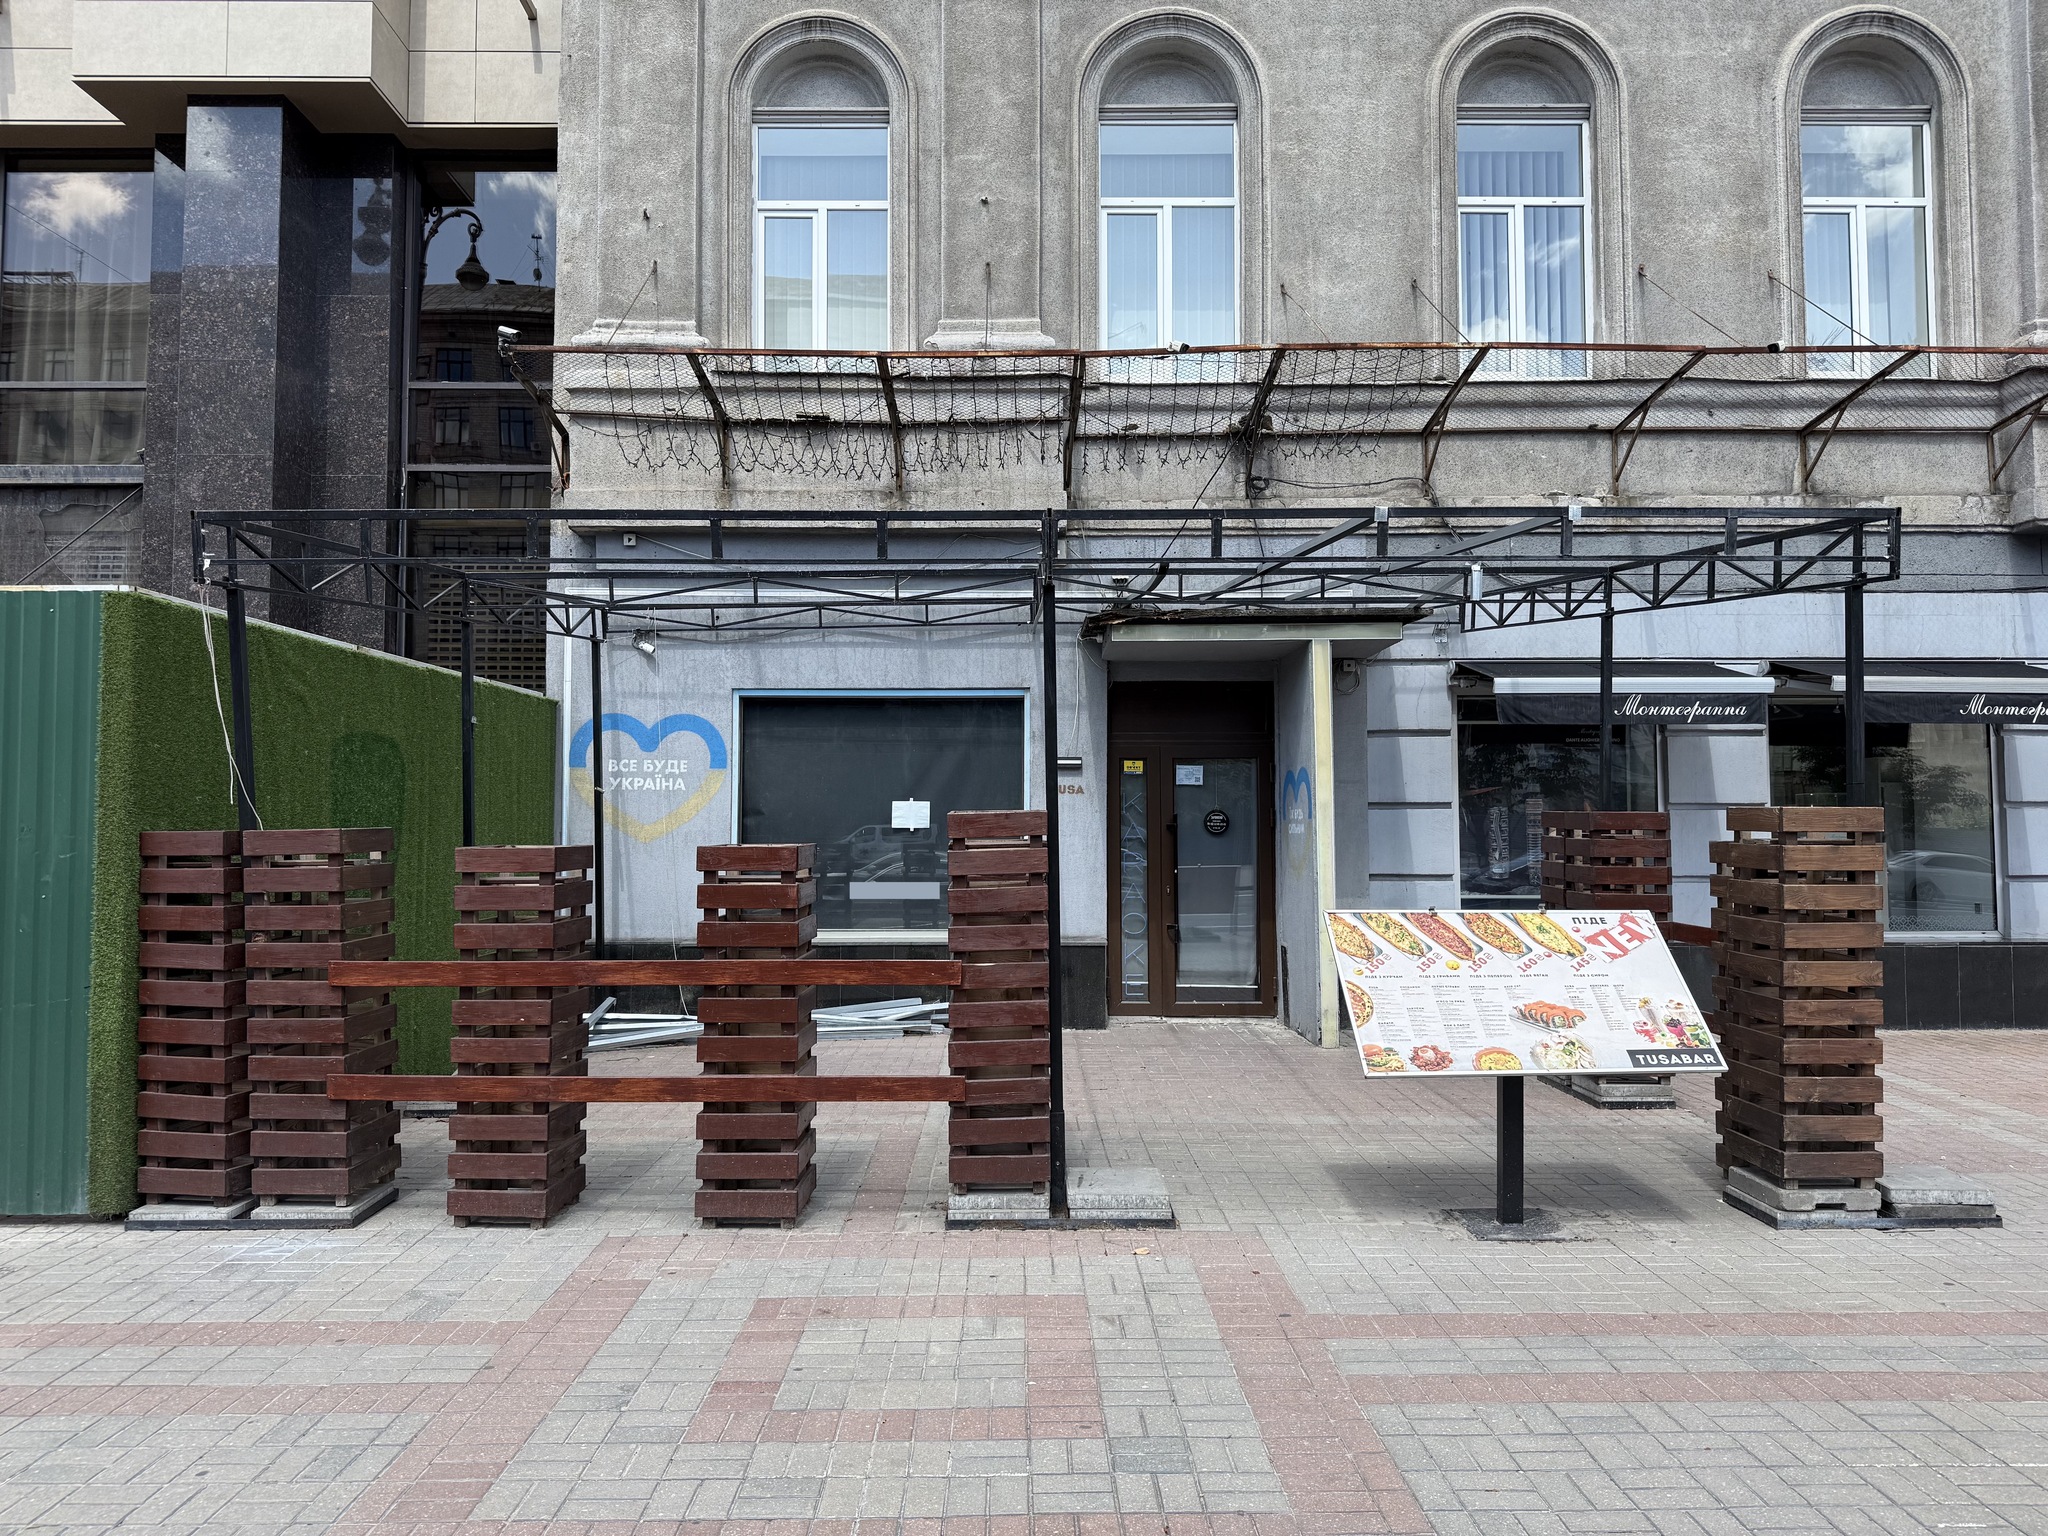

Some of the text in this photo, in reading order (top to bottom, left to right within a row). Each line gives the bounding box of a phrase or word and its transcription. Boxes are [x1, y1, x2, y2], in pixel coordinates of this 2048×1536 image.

[1614, 693, 1748, 724] Монтеграппа
[1959, 693, 2048, 724] Монтегр
[608, 759, 688, 775] ВСЕ БУДЕ
[608, 775, 687, 791] УКРАЇНА
[1121, 791, 1148, 996] KARAOKE
[1571, 916, 1608, 925] ПІДЕ
[1588, 915, 1656, 963] NEW
[1635, 1053, 1717, 1066] TUSABAR
